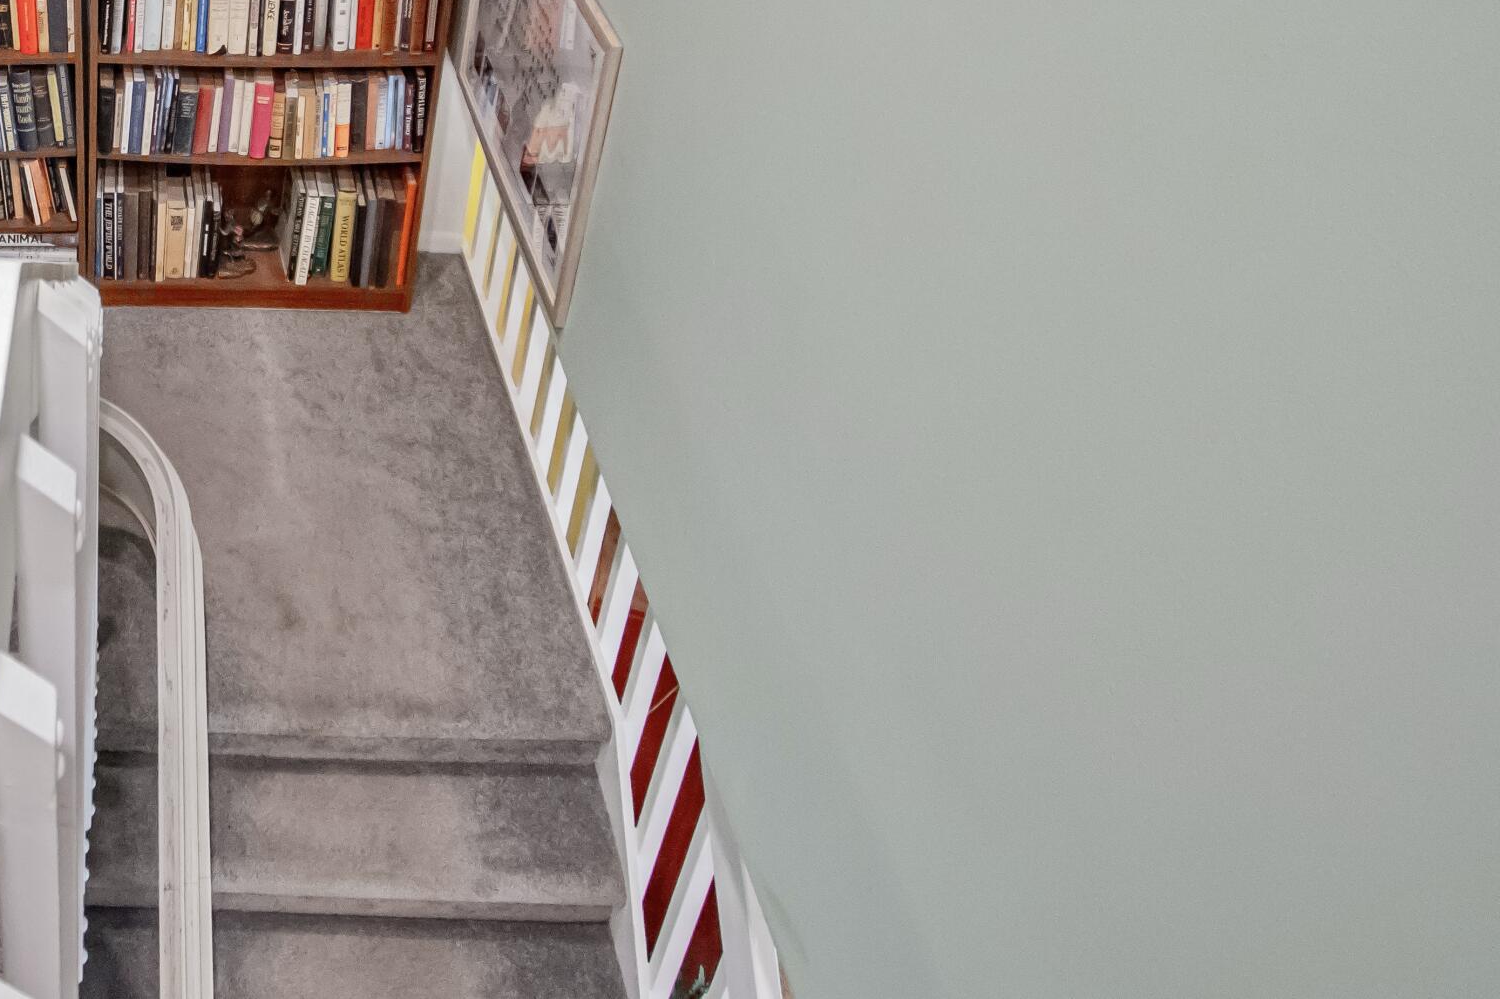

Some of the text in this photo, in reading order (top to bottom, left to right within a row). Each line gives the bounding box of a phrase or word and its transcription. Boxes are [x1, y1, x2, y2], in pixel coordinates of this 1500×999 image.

[418, 77, 427, 103] JEWISH
[105, 202, 113, 270] THE JEWISH WORLD
[298, 198, 317, 279] CHAGALL BY CHAGALL
[336, 215, 350, 274] WORLD ATLAS
